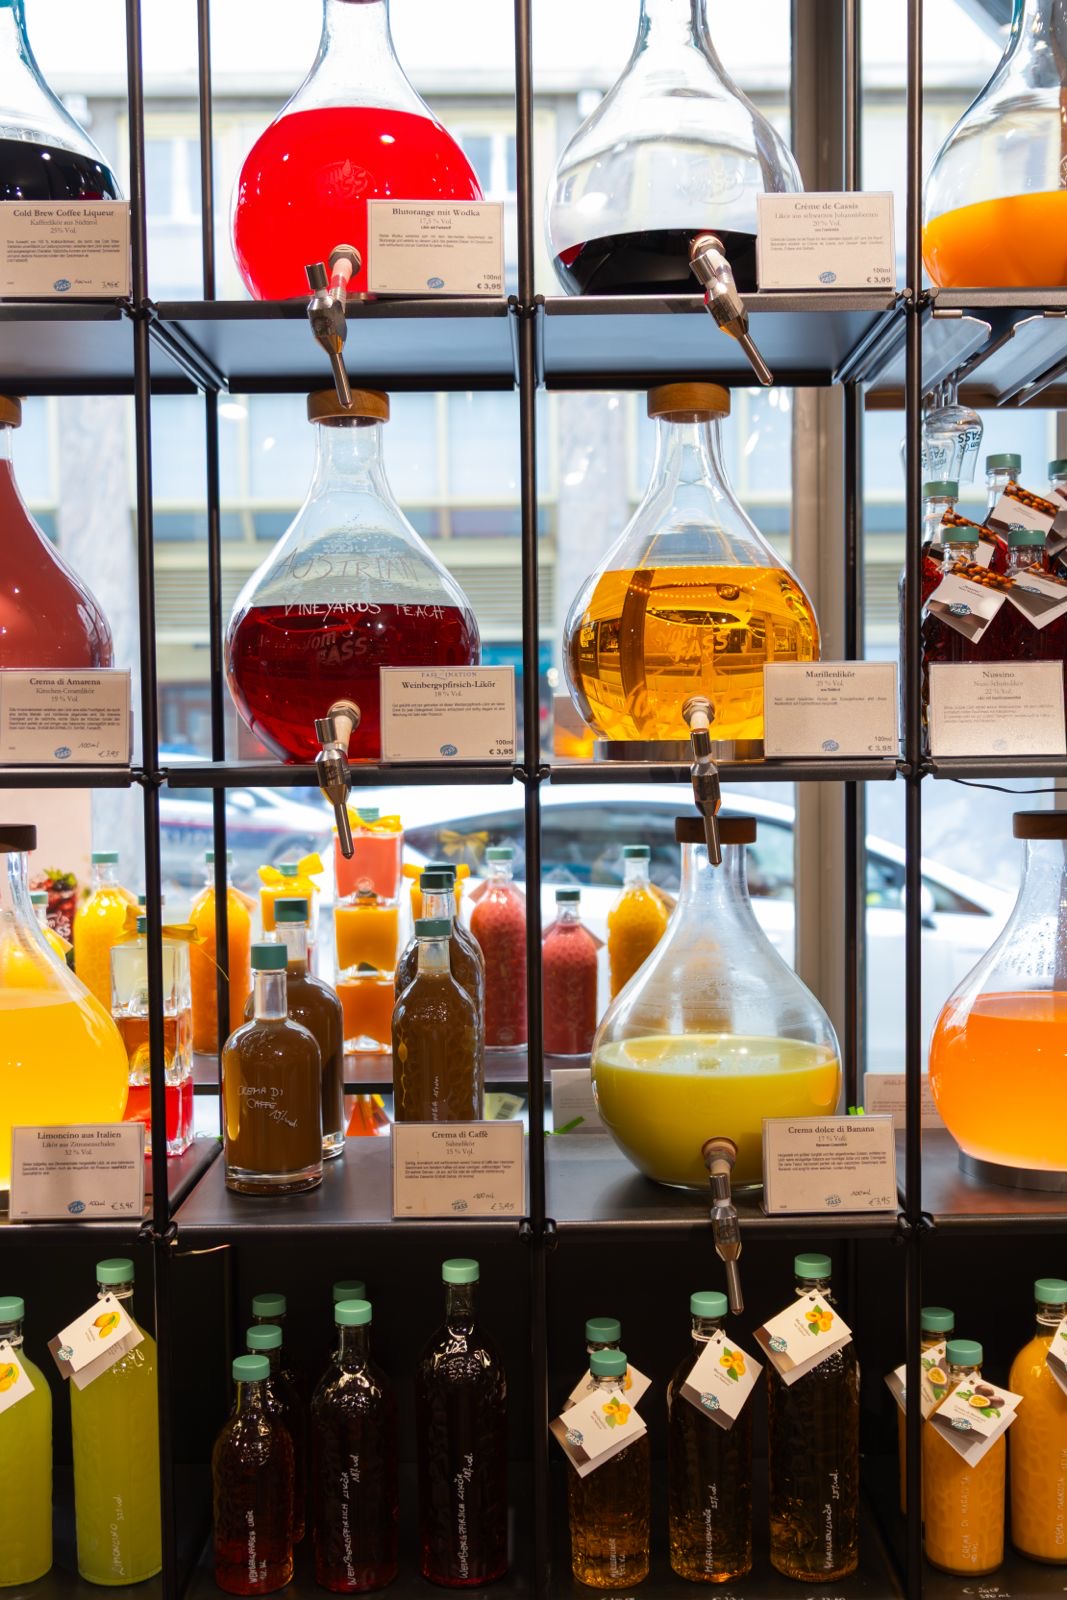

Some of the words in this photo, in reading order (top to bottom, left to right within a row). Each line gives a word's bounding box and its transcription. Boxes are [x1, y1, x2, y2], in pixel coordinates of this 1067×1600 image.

[822, 202, 831, 210] de
[833, 202, 859, 210] Cassis
[13, 209, 32, 217] Cold
[34, 209, 54, 217] Brew
[56, 208, 81, 217] Coffee
[83, 209, 114, 218] Liqueur
[392, 207, 436, 217] Blutorange
[437, 208, 451, 216] mit
[452, 208, 480, 217] Wodka
[282, 596, 382, 622] VINEYARDS
[395, 602, 446, 620] PEACH
[805, 670, 855, 678] Marillenlikör
[29, 678, 55, 686] Crema
[57, 678, 64, 686] di
[66, 678, 101, 686] Amarena
[401, 680, 496, 690] Weinbergspfirsich-Likör
[788, 1126, 813, 1134] Crema
[836, 1125, 845, 1133] di
[846, 1125, 875, 1133] Banana
[37, 1131, 80, 1140] Limoncino
[96, 1131, 122, 1139] Italien
[432, 1131, 457, 1139] Crema
[468, 1130, 489, 1138] Caffè
